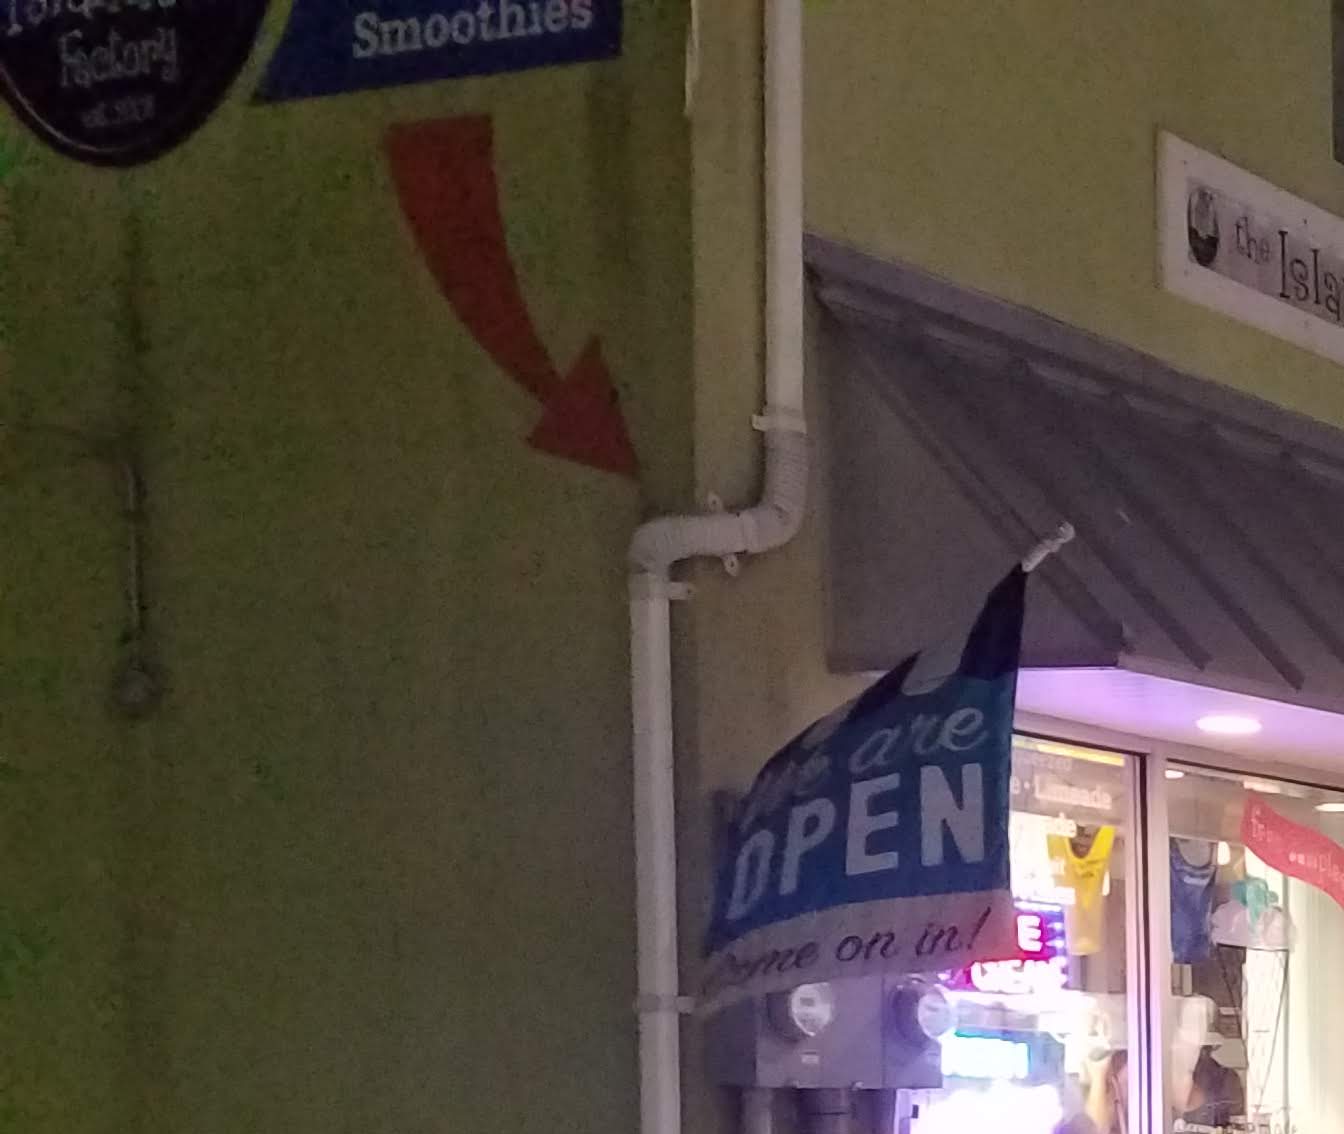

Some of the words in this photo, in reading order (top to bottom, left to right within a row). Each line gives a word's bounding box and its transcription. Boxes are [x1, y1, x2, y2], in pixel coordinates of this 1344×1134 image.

[57, 26, 177, 88] Factory
[351, 0, 594, 59] Smoothies
[1234, 216, 1271, 264] the
[849, 706, 990, 776] are
[725, 762, 986, 921] OPEN
[834, 932, 897, 962] on
[912, 906, 993, 958] in!
